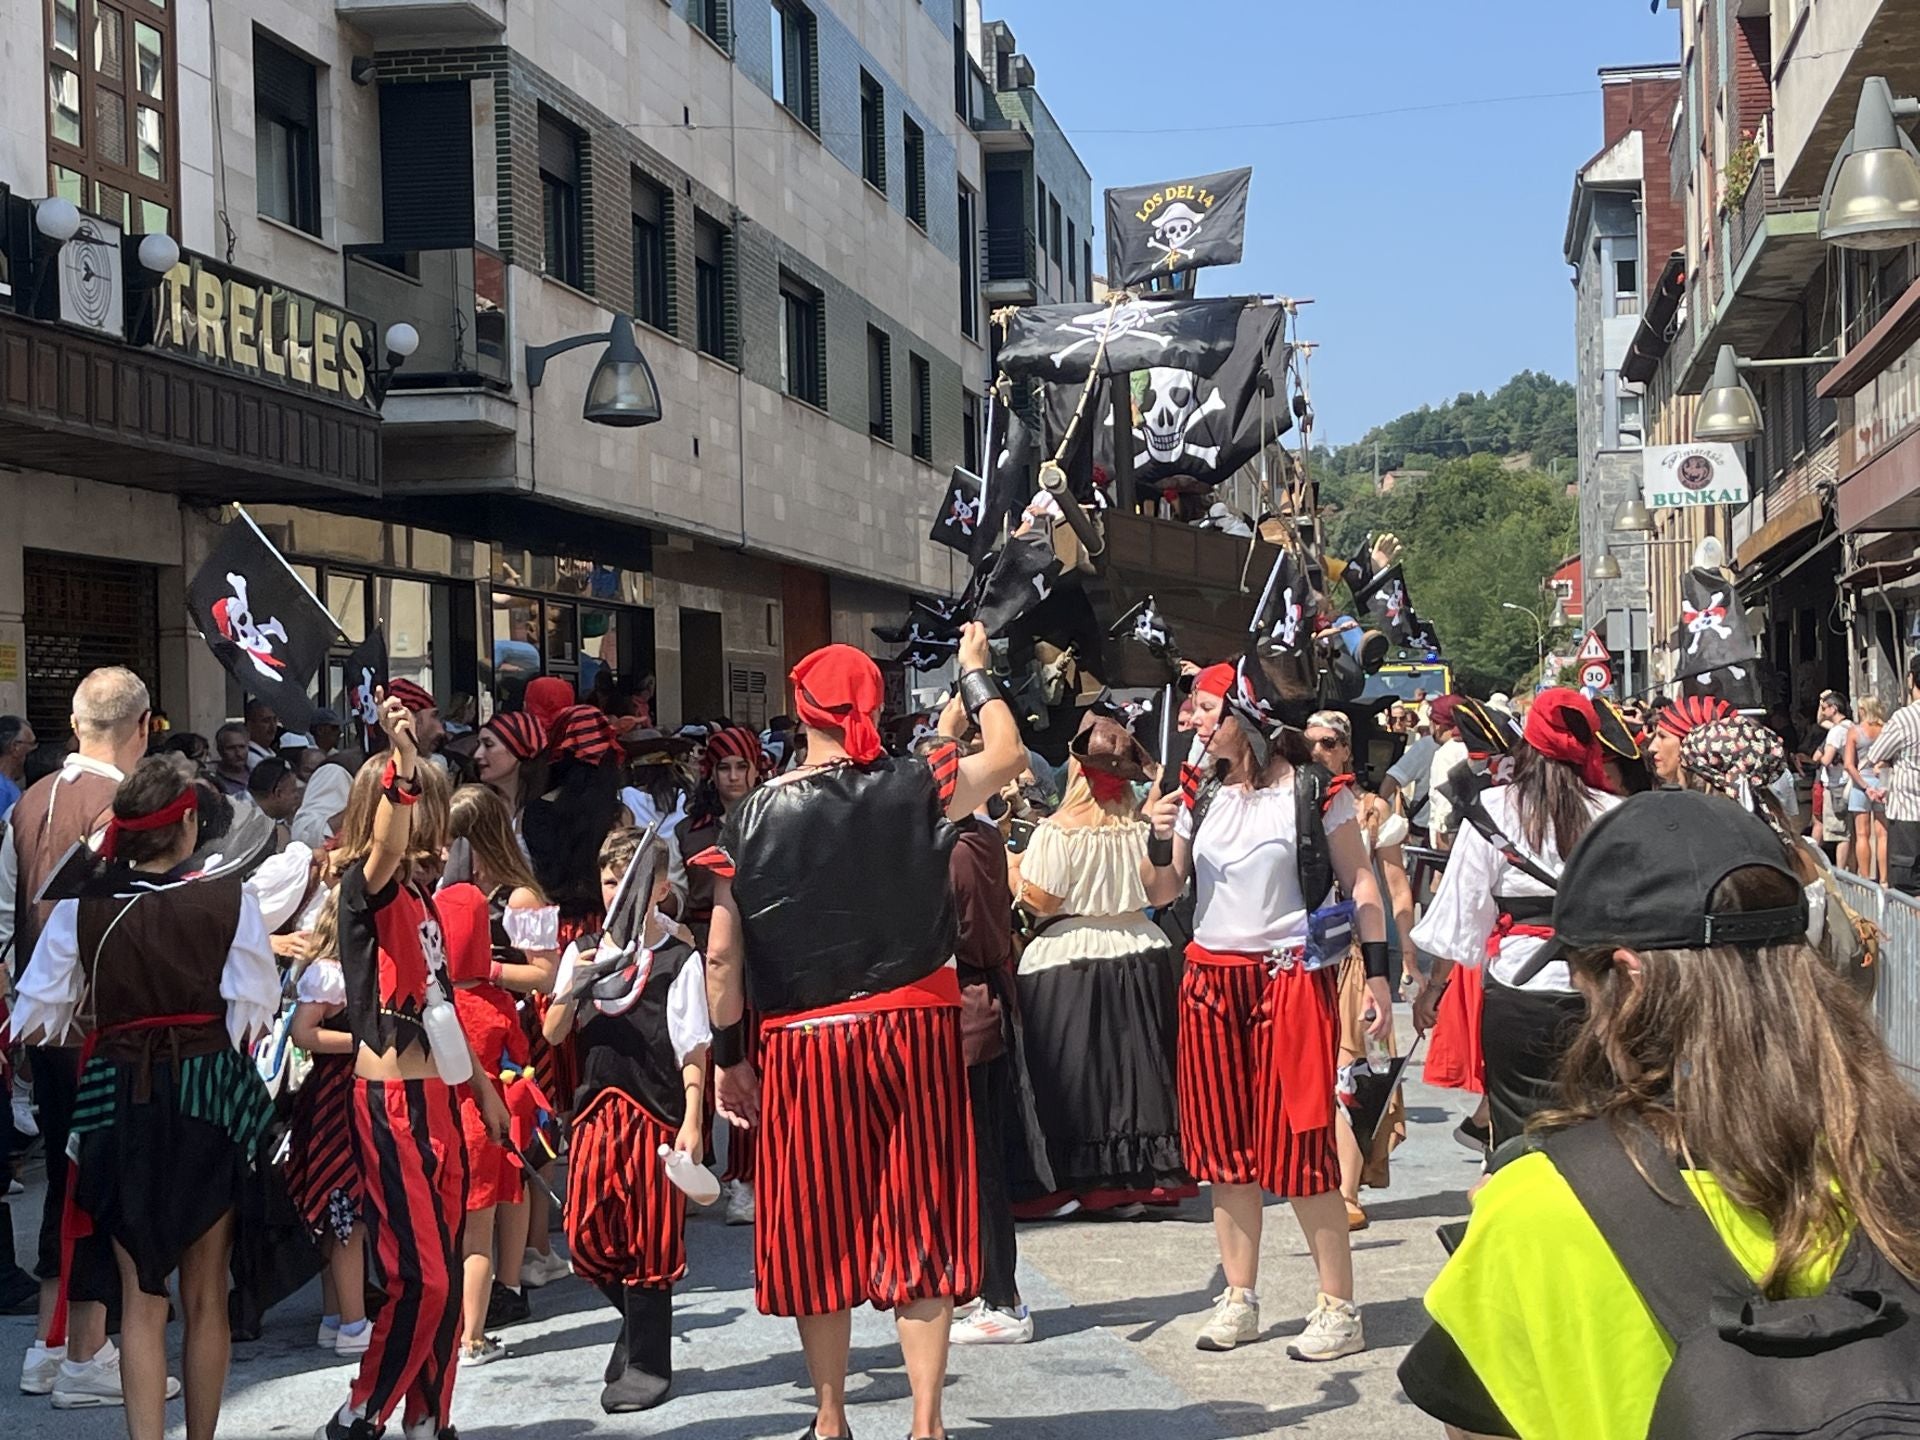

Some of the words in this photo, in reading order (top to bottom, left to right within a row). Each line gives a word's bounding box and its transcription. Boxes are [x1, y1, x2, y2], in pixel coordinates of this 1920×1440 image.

[1135, 193, 1163, 222] LOS
[1165, 186, 1195, 201] DEL
[1197, 190, 1215, 208] 14
[163, 262, 365, 400] TRELLES
[1653, 489, 1741, 506] BUNKAI
[1586, 672, 1603, 682] 30
